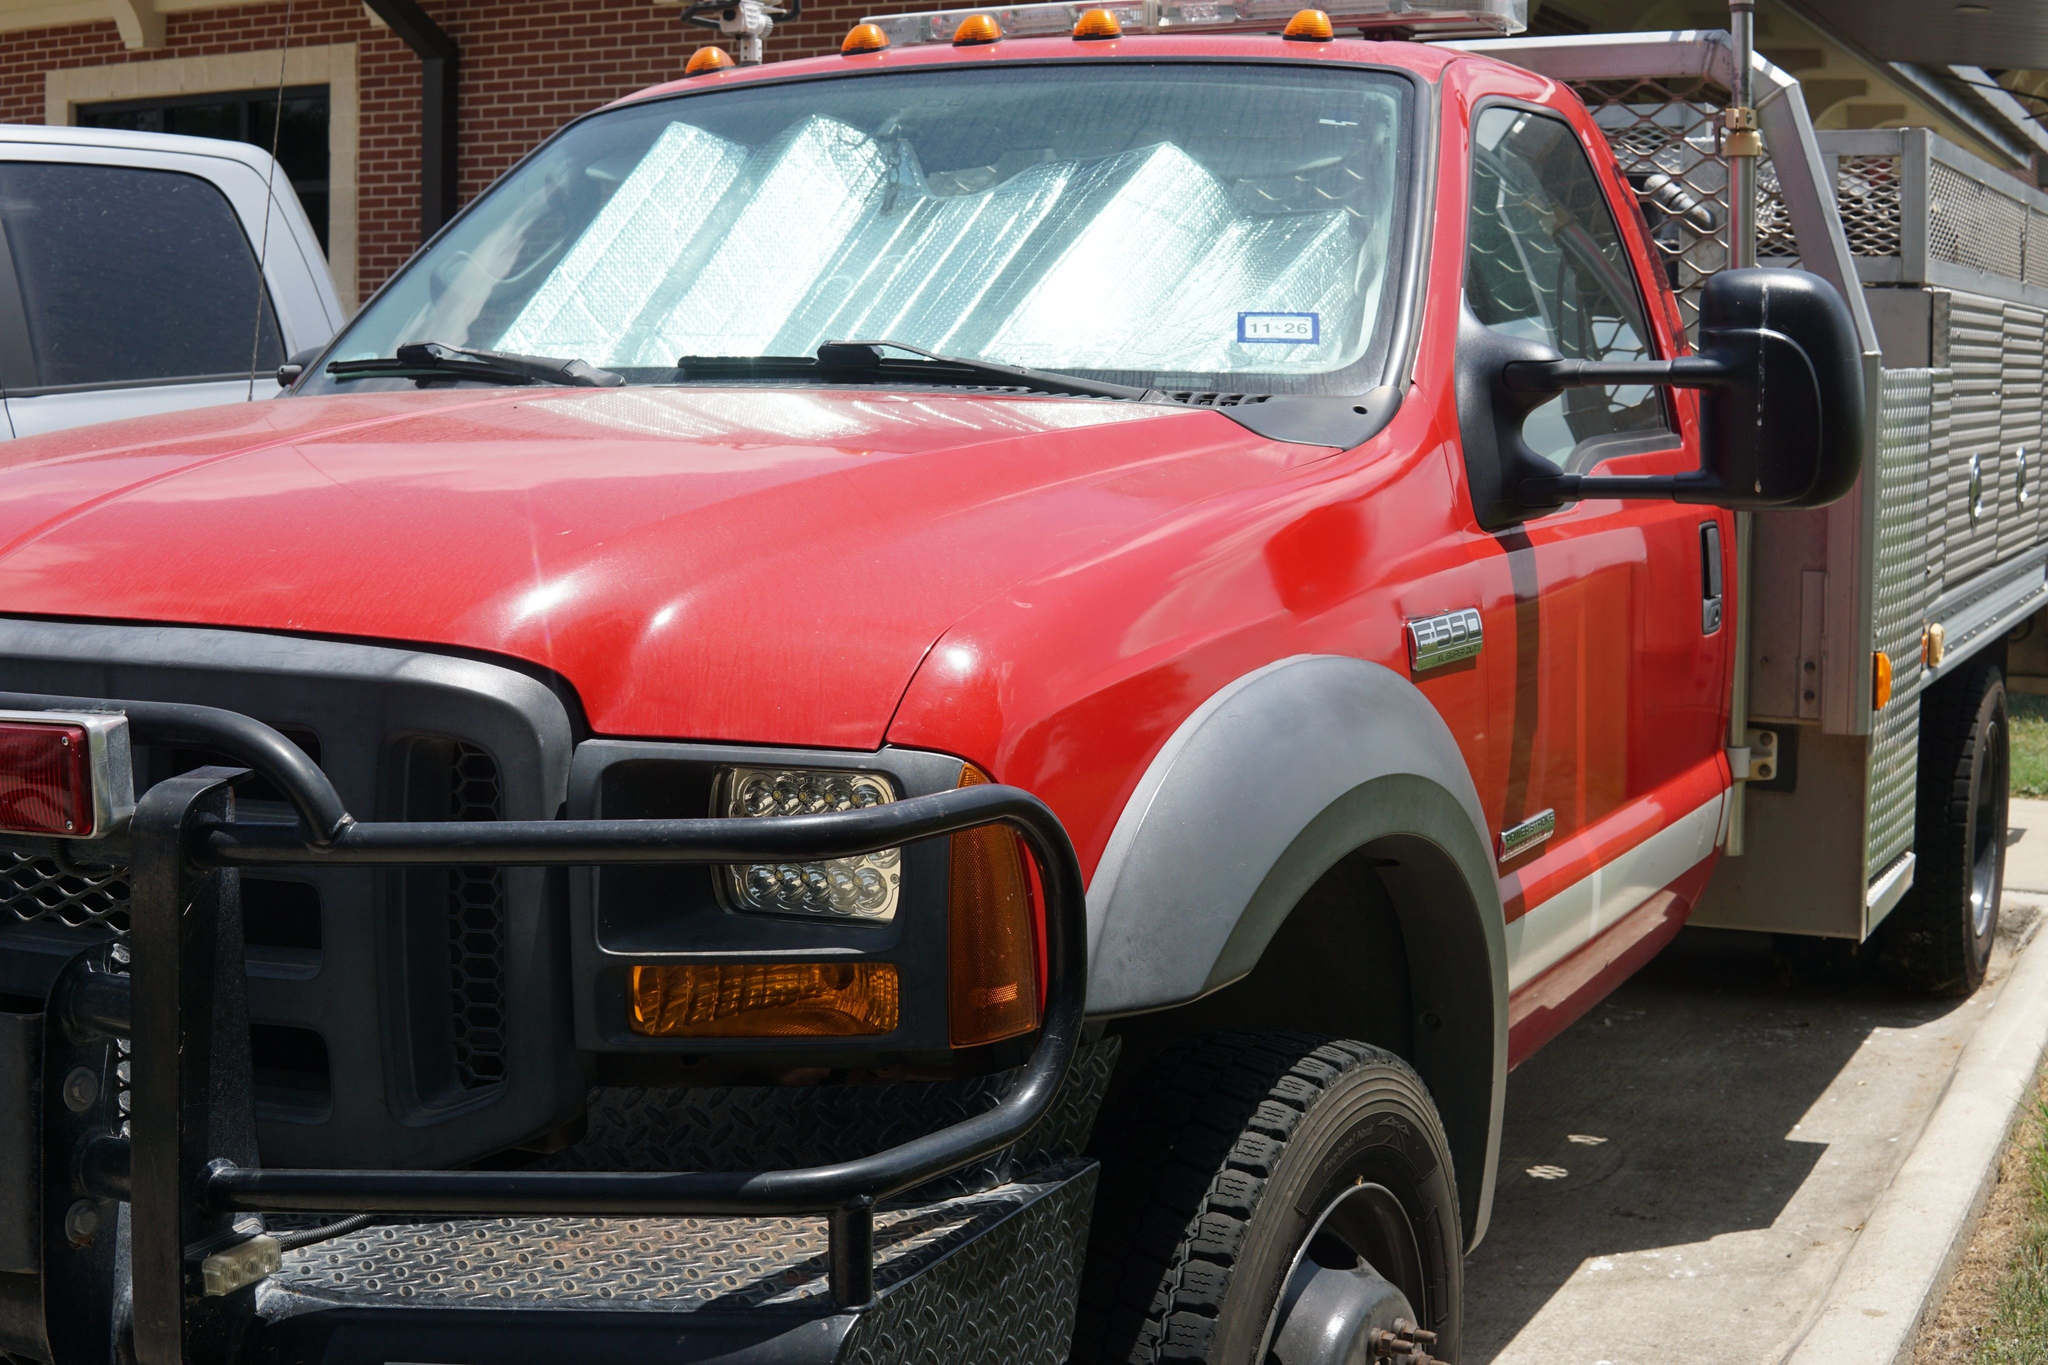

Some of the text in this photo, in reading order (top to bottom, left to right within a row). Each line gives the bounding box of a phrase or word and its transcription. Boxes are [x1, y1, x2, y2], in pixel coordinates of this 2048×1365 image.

[1284, 323, 1308, 334] 26
[1413, 612, 1482, 653] F-550
[1446, 648, 1465, 660] SUPER
[1466, 644, 1481, 655] DUTY
[1506, 812, 1554, 843] POWER STROKE
